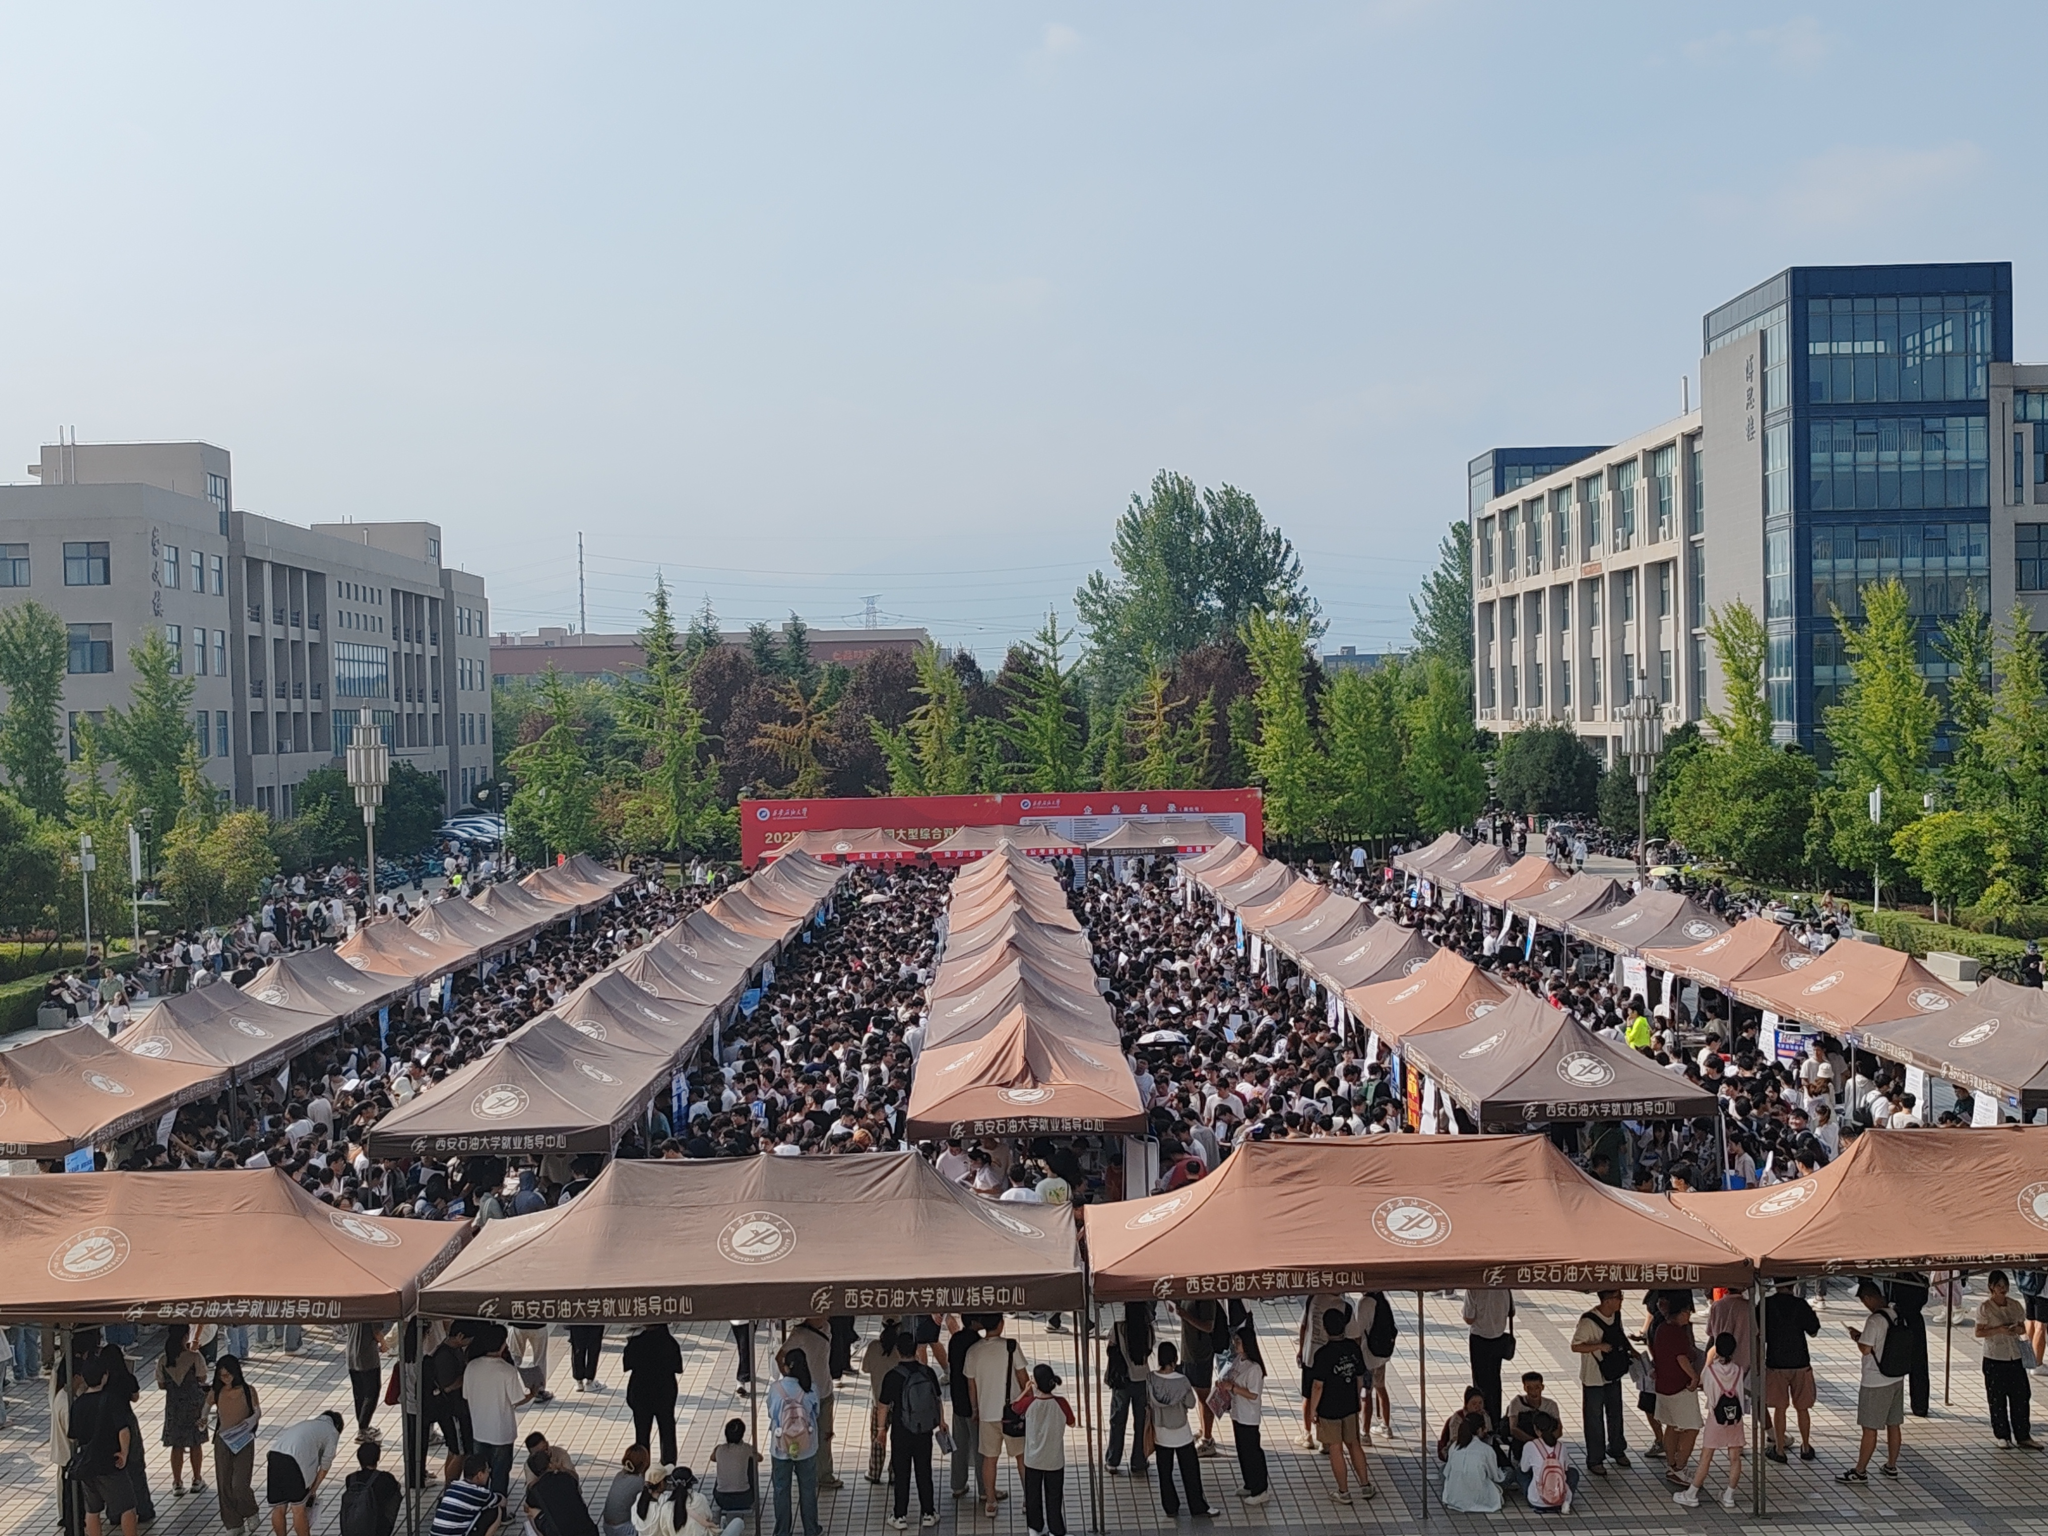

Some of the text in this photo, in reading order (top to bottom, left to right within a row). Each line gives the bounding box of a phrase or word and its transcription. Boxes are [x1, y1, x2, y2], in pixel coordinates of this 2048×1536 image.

[1083, 803, 1177, 815] 企业名录
[885, 827, 959, 841] 国大型综合双
[1546, 1101, 1676, 1117] 西安石油大学就业指导中心
[974, 1117, 1105, 1136] 西安石油大学就业指导中心
[435, 1133, 567, 1150] 西安石油大学就业指导中心
[1185, 1271, 1366, 1294] 西安石油大学就业指导中心
[1517, 1263, 1700, 1284] 西安石油大学就业指导中心
[844, 1285, 1026, 1309] 西安石油大学就业指导中心
[157, 1298, 341, 1319] 西安石油大学就业指导中心
[511, 1295, 693, 1320] 西安石油大学就业指导中心
